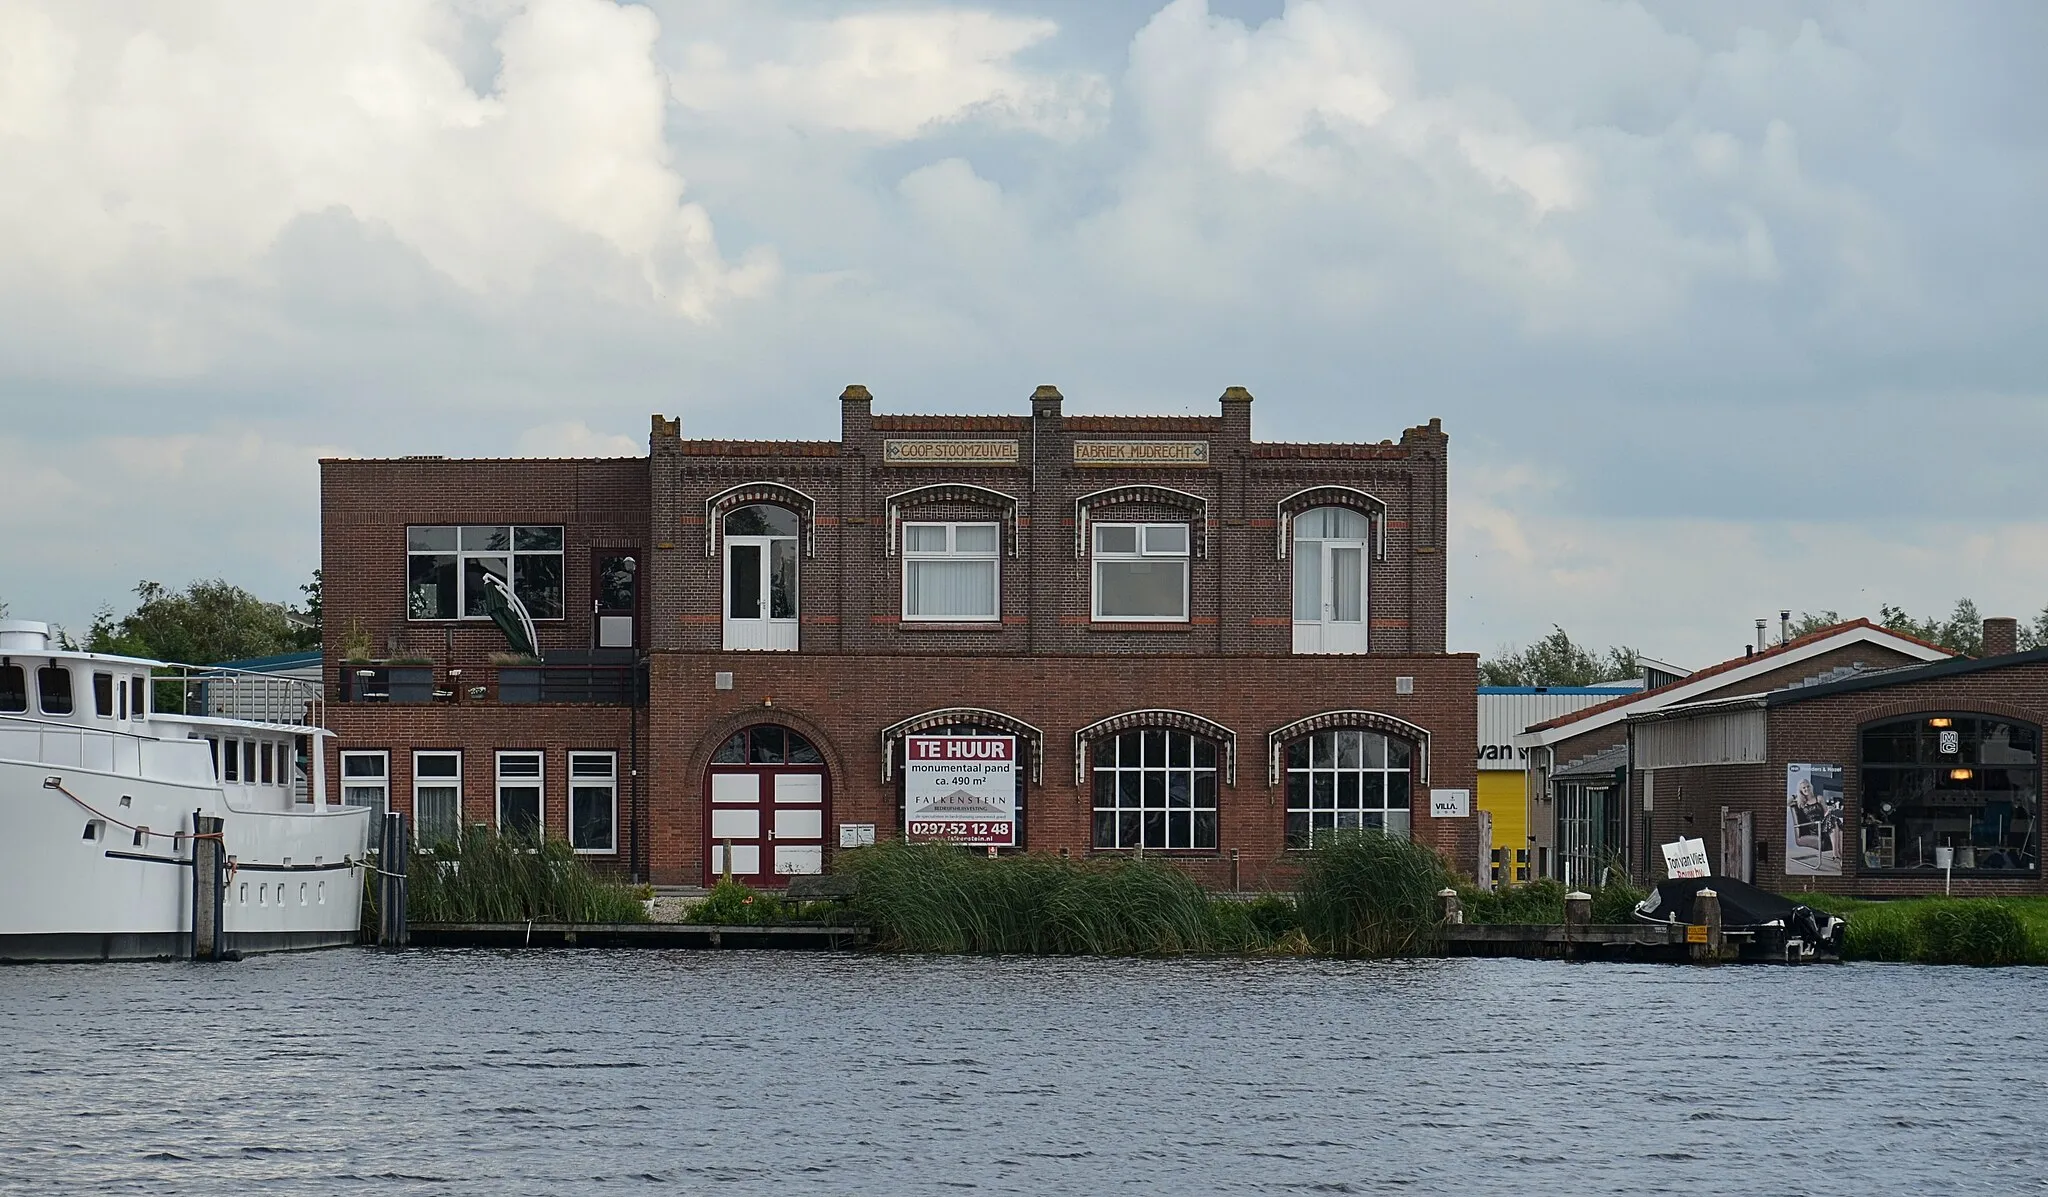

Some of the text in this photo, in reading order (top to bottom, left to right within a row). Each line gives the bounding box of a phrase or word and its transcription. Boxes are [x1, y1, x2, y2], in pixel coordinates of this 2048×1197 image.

[1076, 445, 1125, 458] FABRIEK
[916, 741, 1005, 758] TE HUUR
[1477, 744, 1512, 760] van
[912, 763, 1010, 774] monumentaal pand
[935, 776, 987, 785] ca. 490 m²
[915, 796, 1006, 804] FALKENSTEIN
[912, 822, 1009, 835] 0297-52 12 48
[1667, 852, 1706, 869] Ton van Vliet
